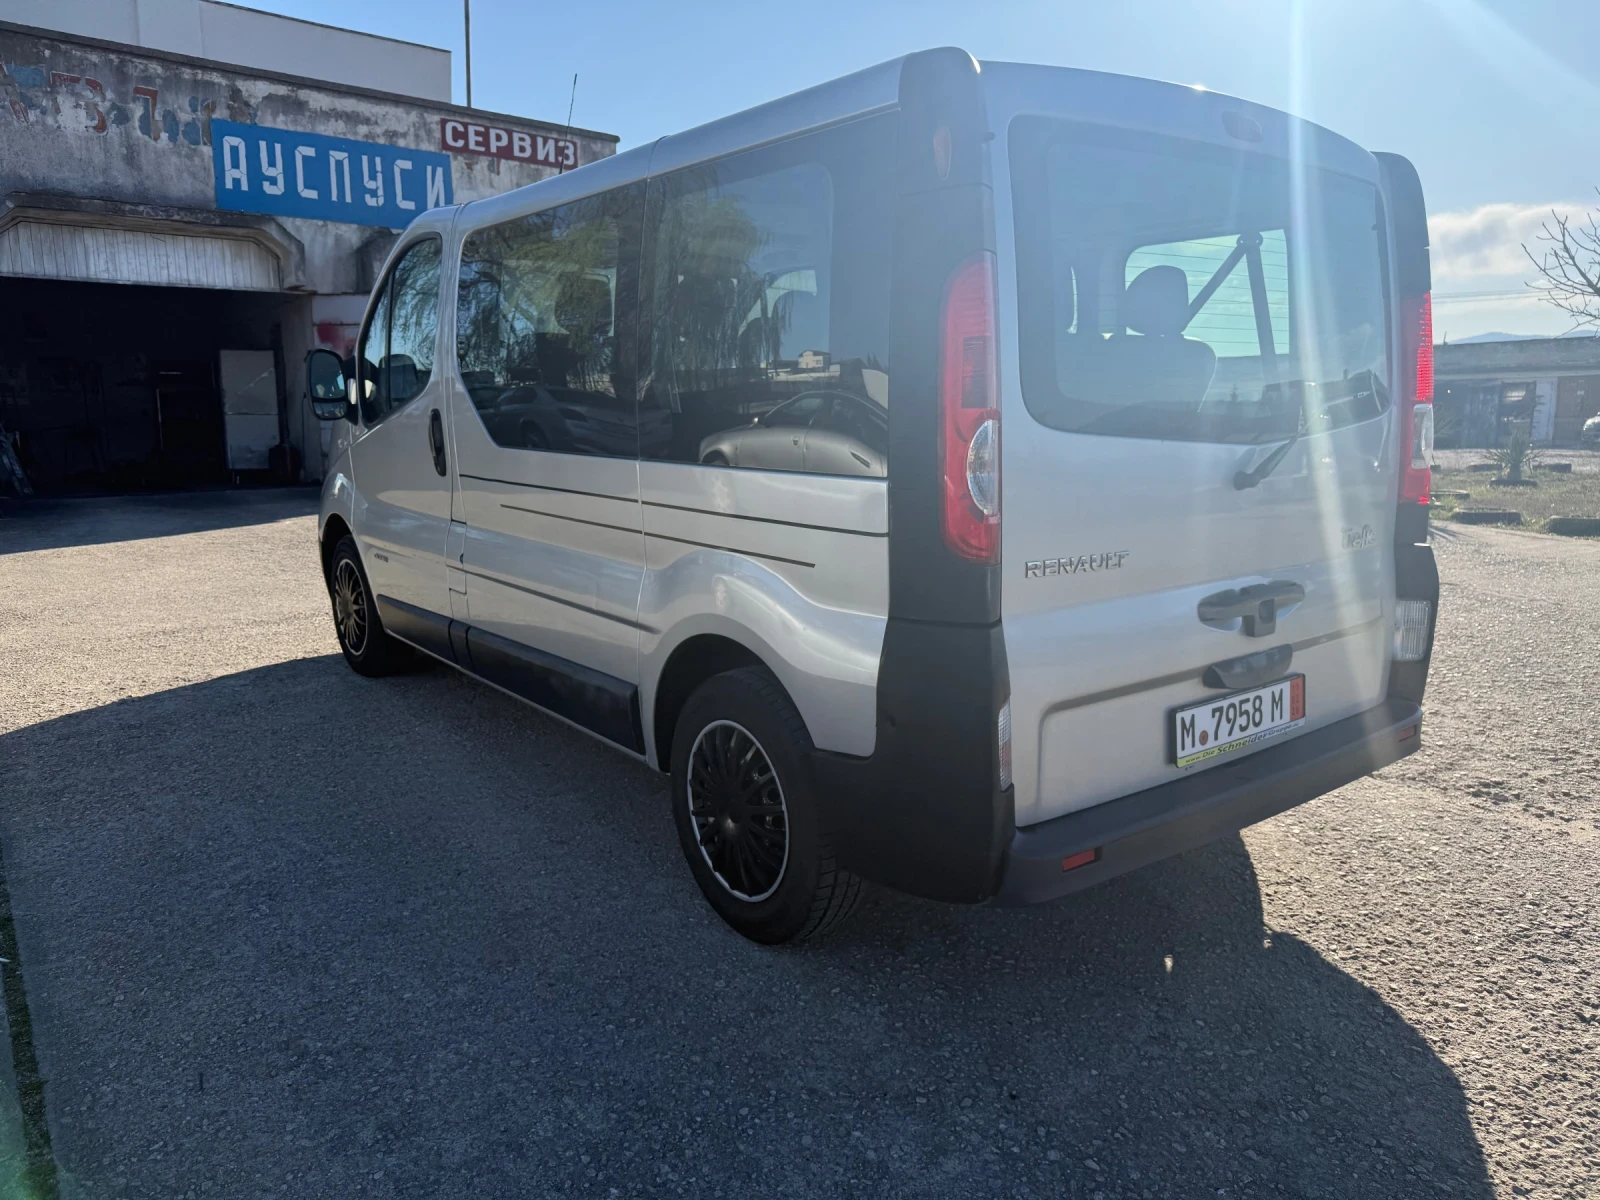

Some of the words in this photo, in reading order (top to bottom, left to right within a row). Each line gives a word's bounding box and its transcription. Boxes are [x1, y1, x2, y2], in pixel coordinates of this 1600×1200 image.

[445, 121, 576, 166] СЕРВИЗ
[223, 135, 446, 210] АУСПУСИ
[1024, 550, 1130, 578] RENAULT
[1181, 713, 1196, 752] M
[1212, 695, 1263, 741] 7958
[1271, 688, 1284, 722] M
